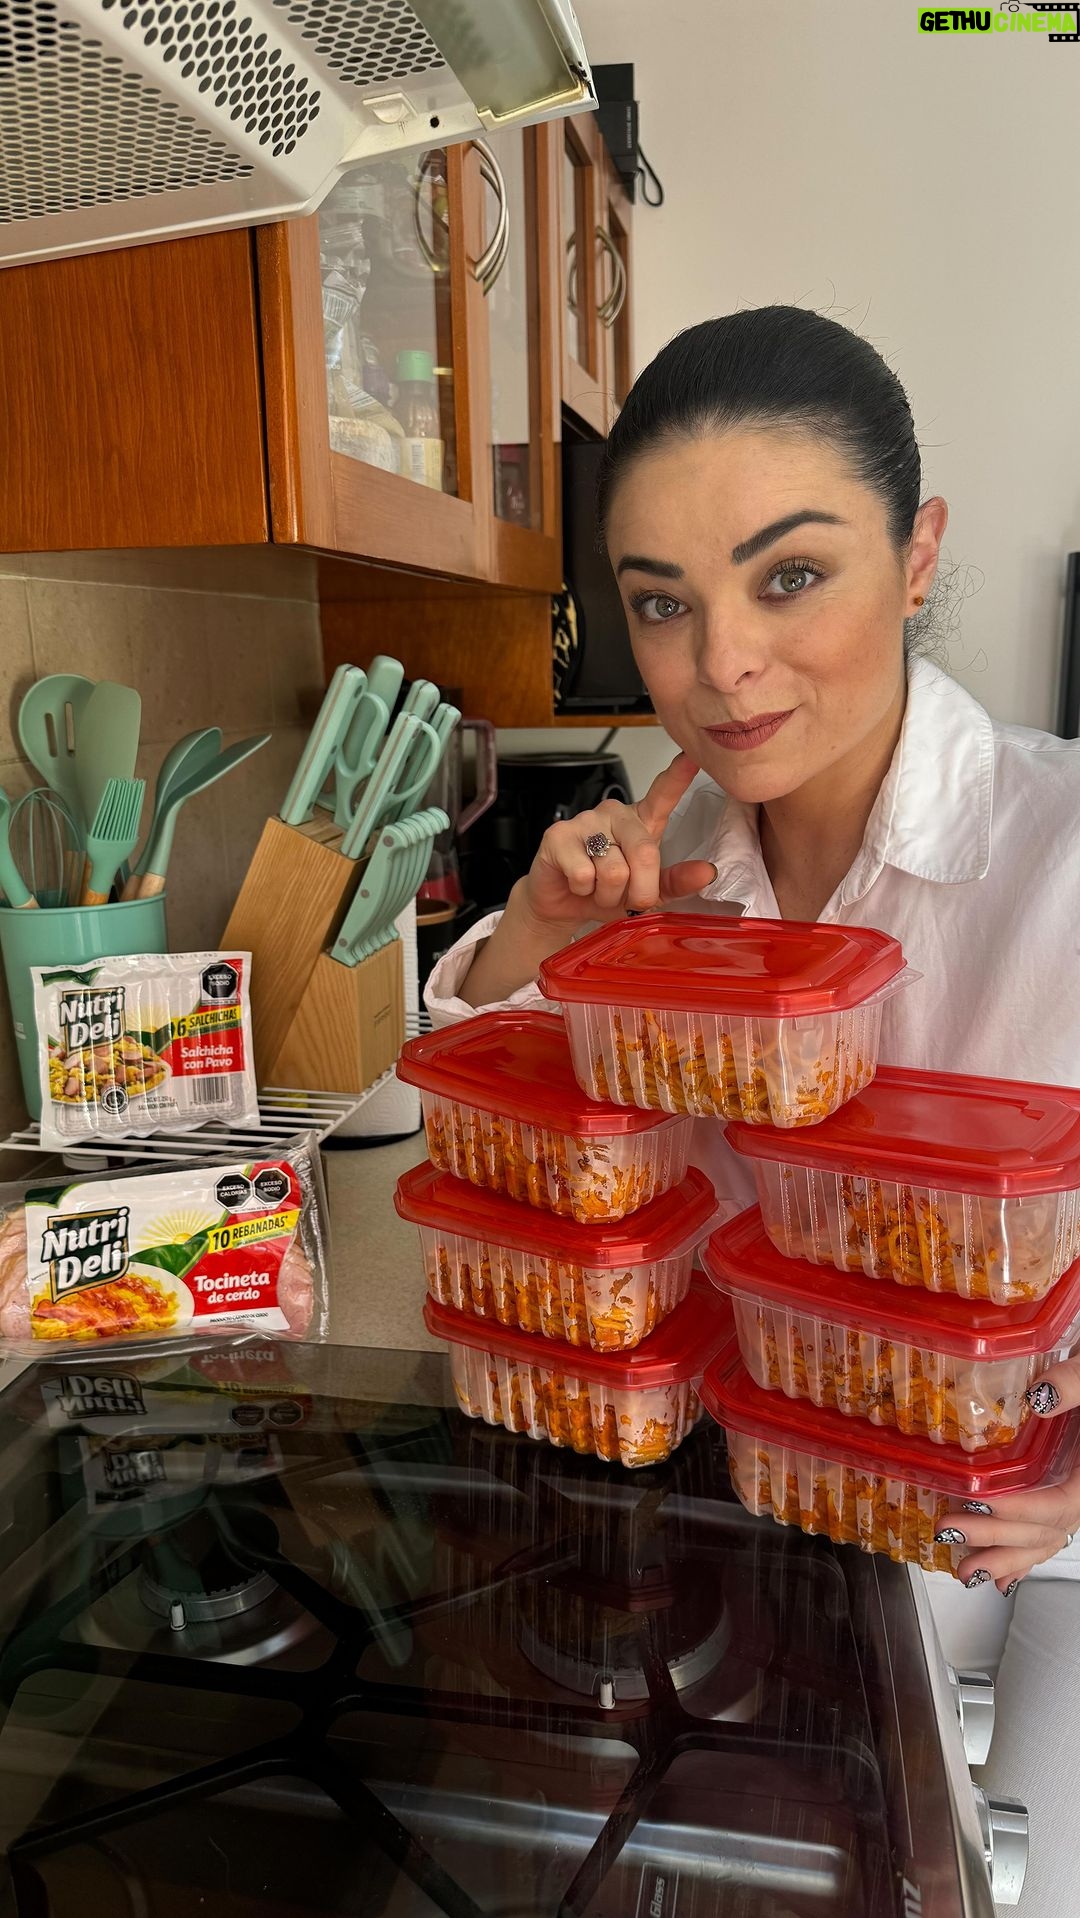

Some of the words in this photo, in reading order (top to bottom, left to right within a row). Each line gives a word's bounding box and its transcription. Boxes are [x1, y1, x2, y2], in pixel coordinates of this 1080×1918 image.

[61, 986, 124, 1025] Nutri
[189, 1008, 237, 1028] SALCHICHAS
[70, 1012, 120, 1048] Deli
[181, 1045, 234, 1058] Salchicha
[183, 1061, 204, 1070] con
[205, 1057, 233, 1068] Pavo
[42, 1207, 128, 1261] Nutri
[213, 1231, 230, 1250] 10
[57, 1240, 122, 1290] Deli
[194, 1270, 270, 1292] Tocineta
[207, 1291, 223, 1304] de
[225, 1287, 260, 1301] cerdo
[650, 1875, 665, 1918] Glass
